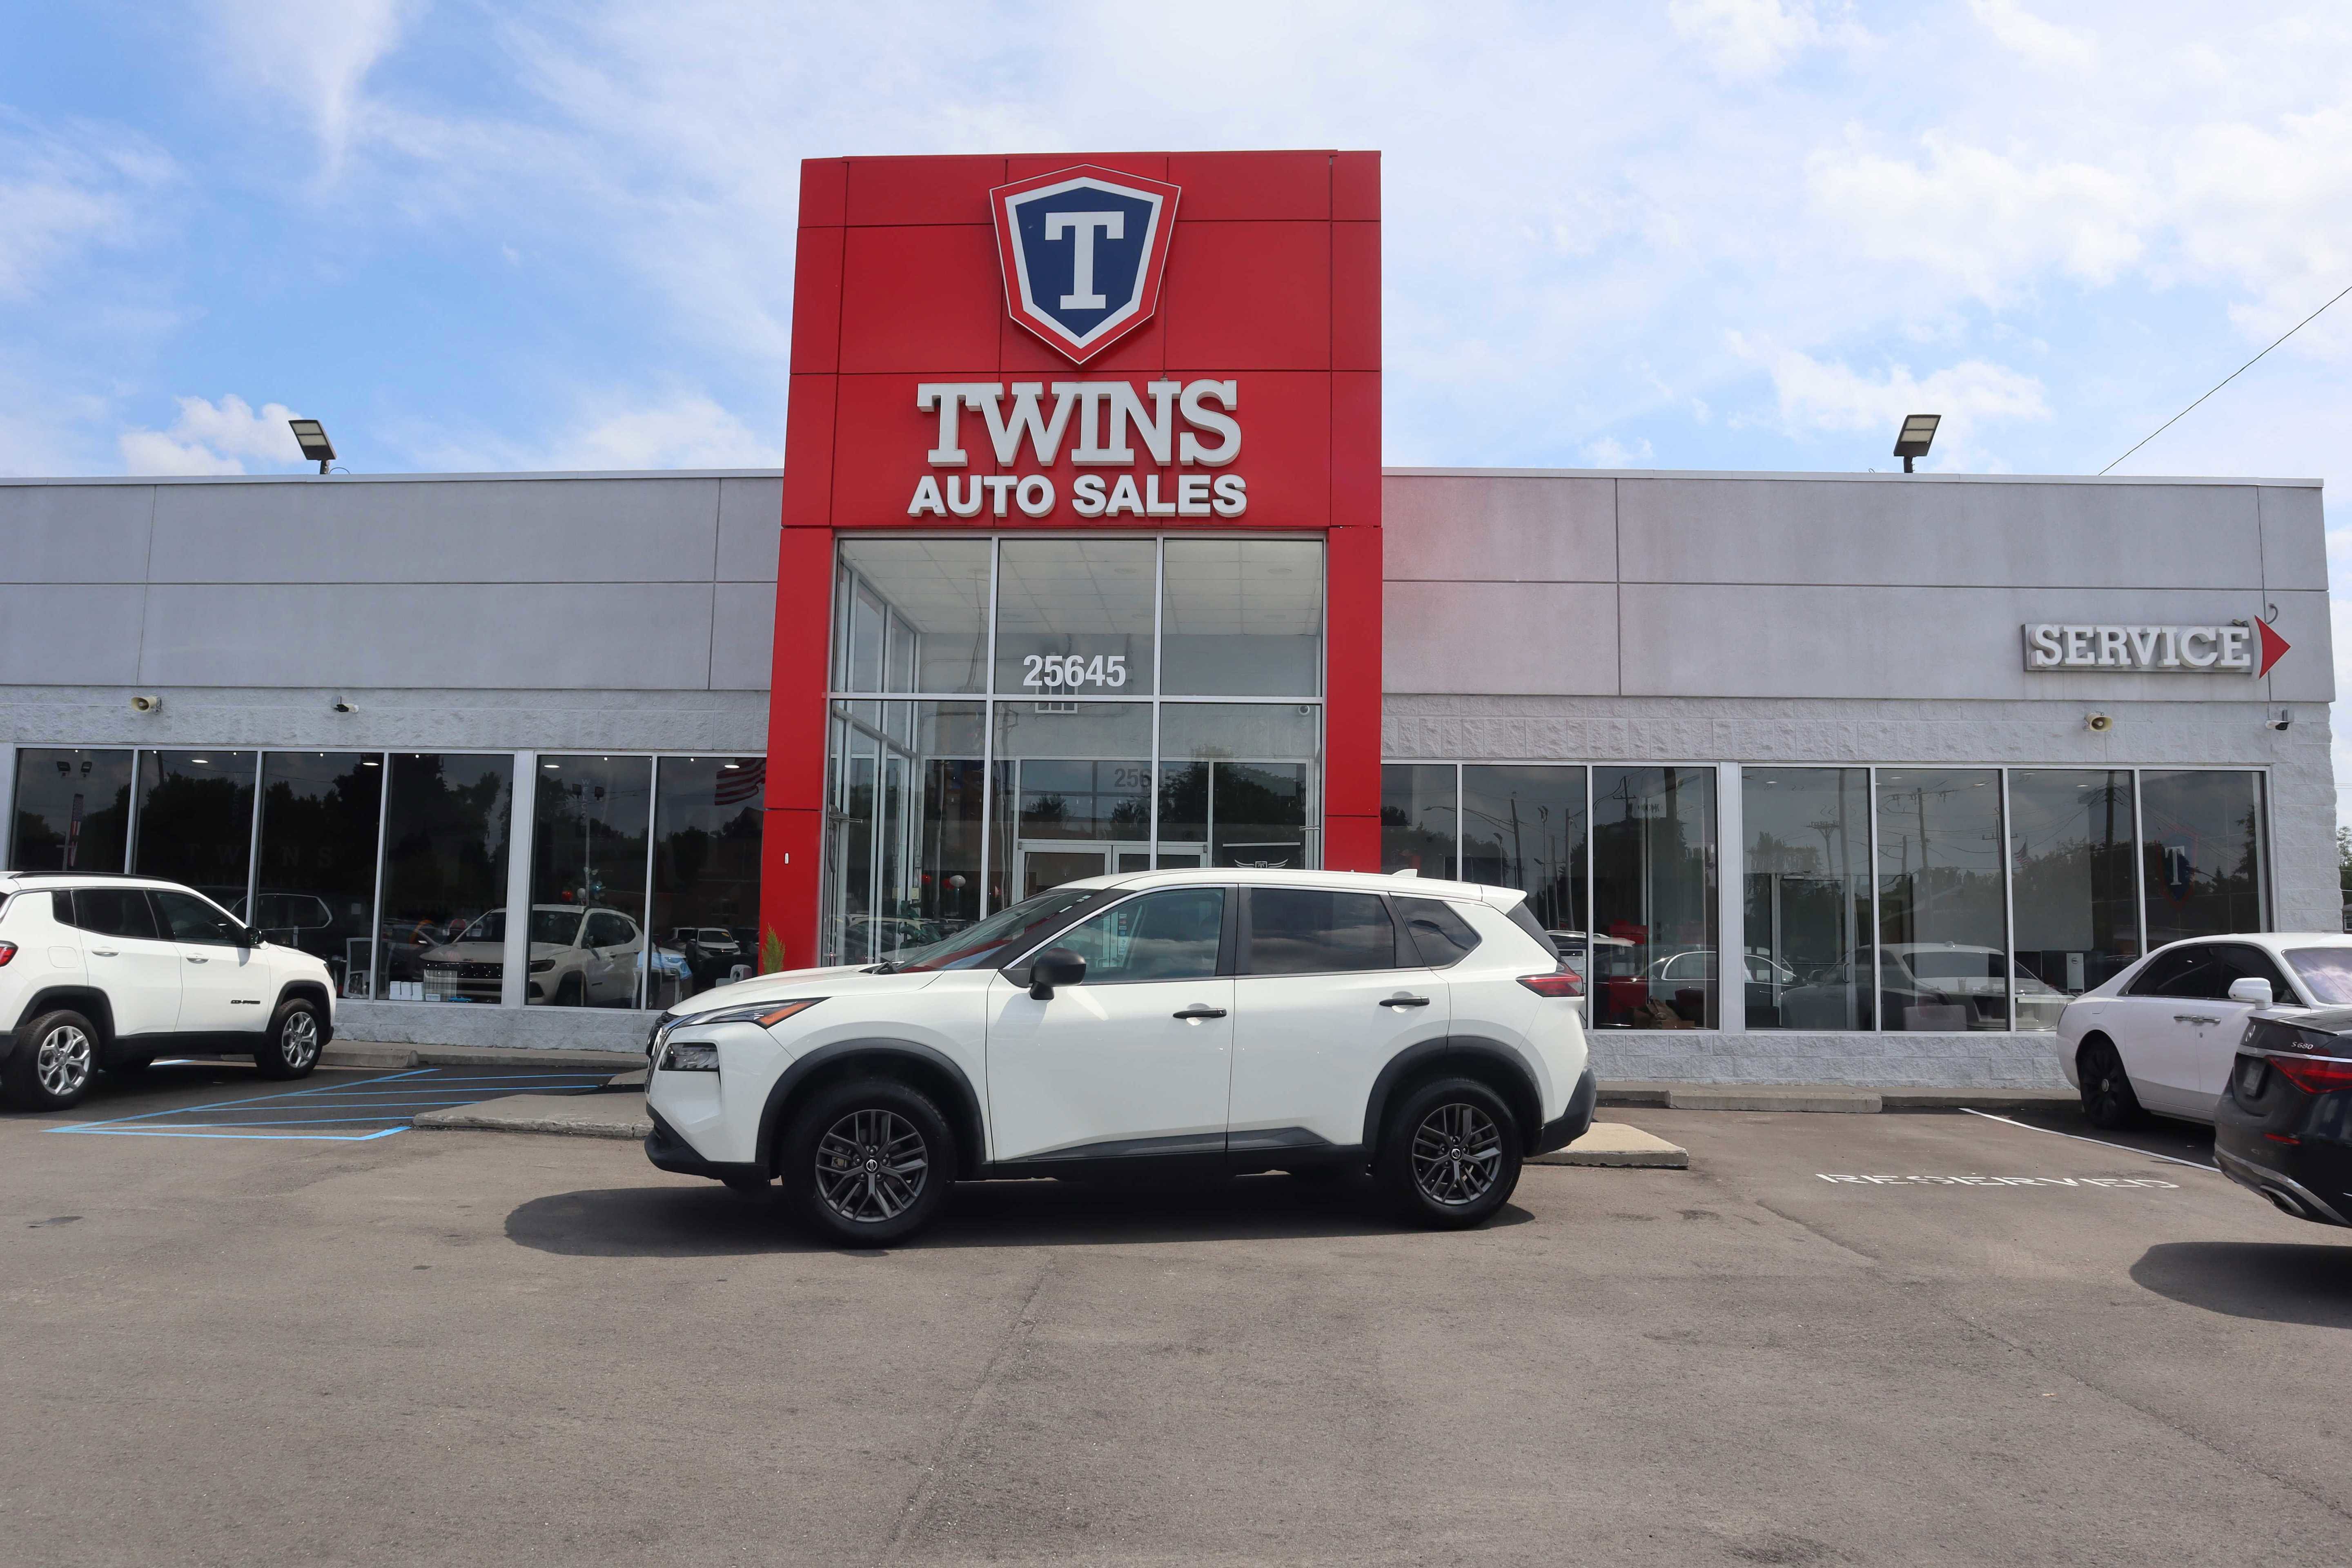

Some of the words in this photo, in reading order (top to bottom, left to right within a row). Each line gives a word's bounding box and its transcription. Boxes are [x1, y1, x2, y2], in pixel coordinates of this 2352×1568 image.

[1045, 211, 1124, 310] T
[916, 379, 1241, 467] TWINS
[907, 474, 1056, 518] AUTO
[1071, 474, 1247, 518] SALES
[2030, 624, 2251, 668] SERVICE
[1022, 655, 1126, 687] 25645
[2165, 846, 2185, 885] T
[1815, 1174, 2180, 1189] RESERVED
